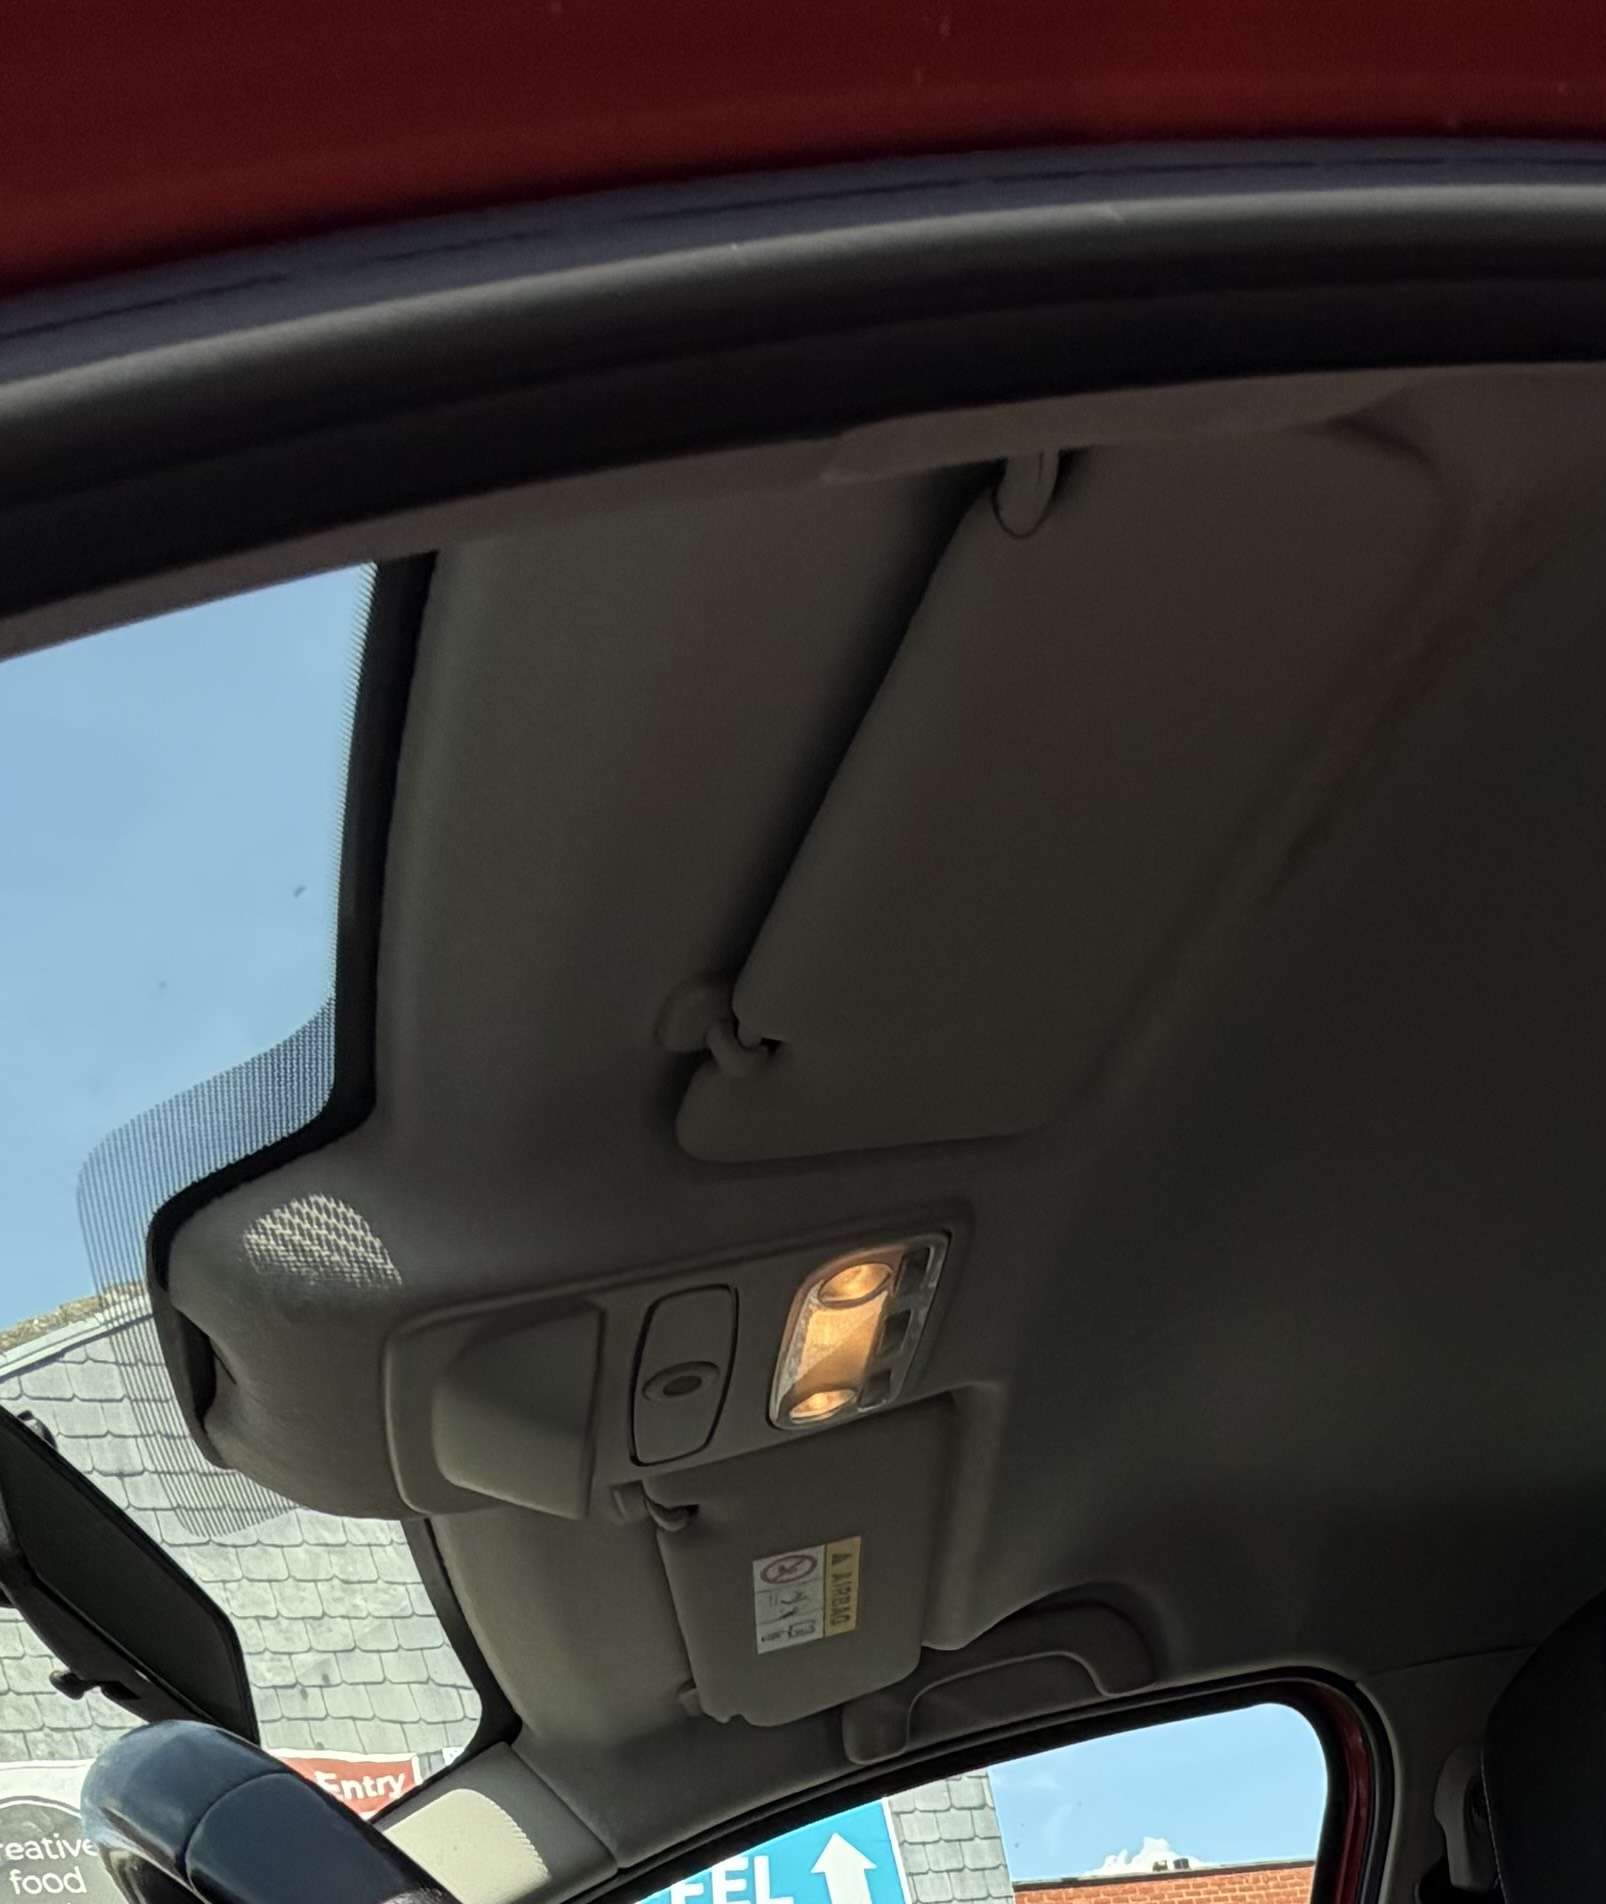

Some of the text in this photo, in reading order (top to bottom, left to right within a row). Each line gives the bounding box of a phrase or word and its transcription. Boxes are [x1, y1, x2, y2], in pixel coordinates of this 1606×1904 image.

[313, 1770, 407, 1801] Entry
[0, 1833, 98, 1861] eative
[9, 1865, 88, 1895] food
